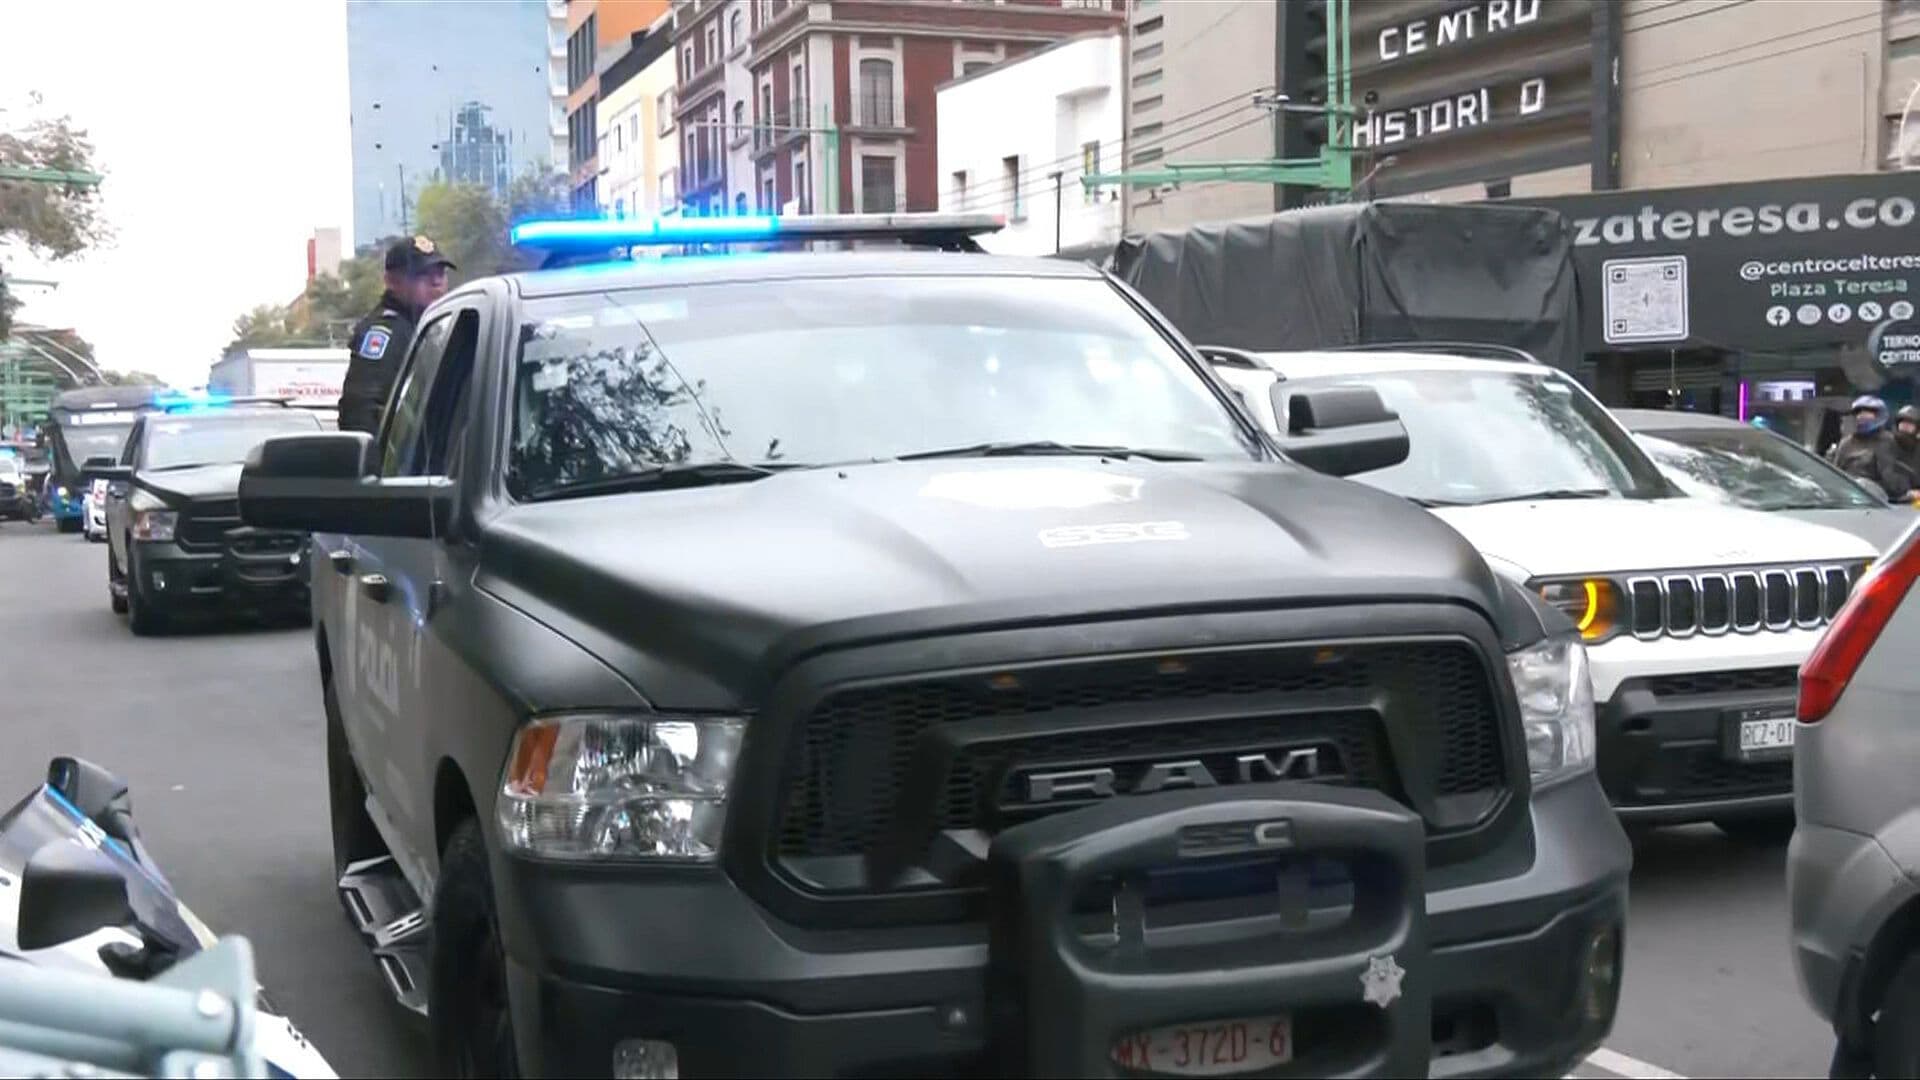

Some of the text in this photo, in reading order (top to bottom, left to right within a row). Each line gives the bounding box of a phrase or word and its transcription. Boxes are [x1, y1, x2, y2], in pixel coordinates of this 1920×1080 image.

[1379, 0, 1541, 60] CENTRO
[1573, 197, 1916, 246] zateresa.co
[1770, 279, 1908, 297] Plaza Teresa
[1029, 749, 1318, 802] RAM
